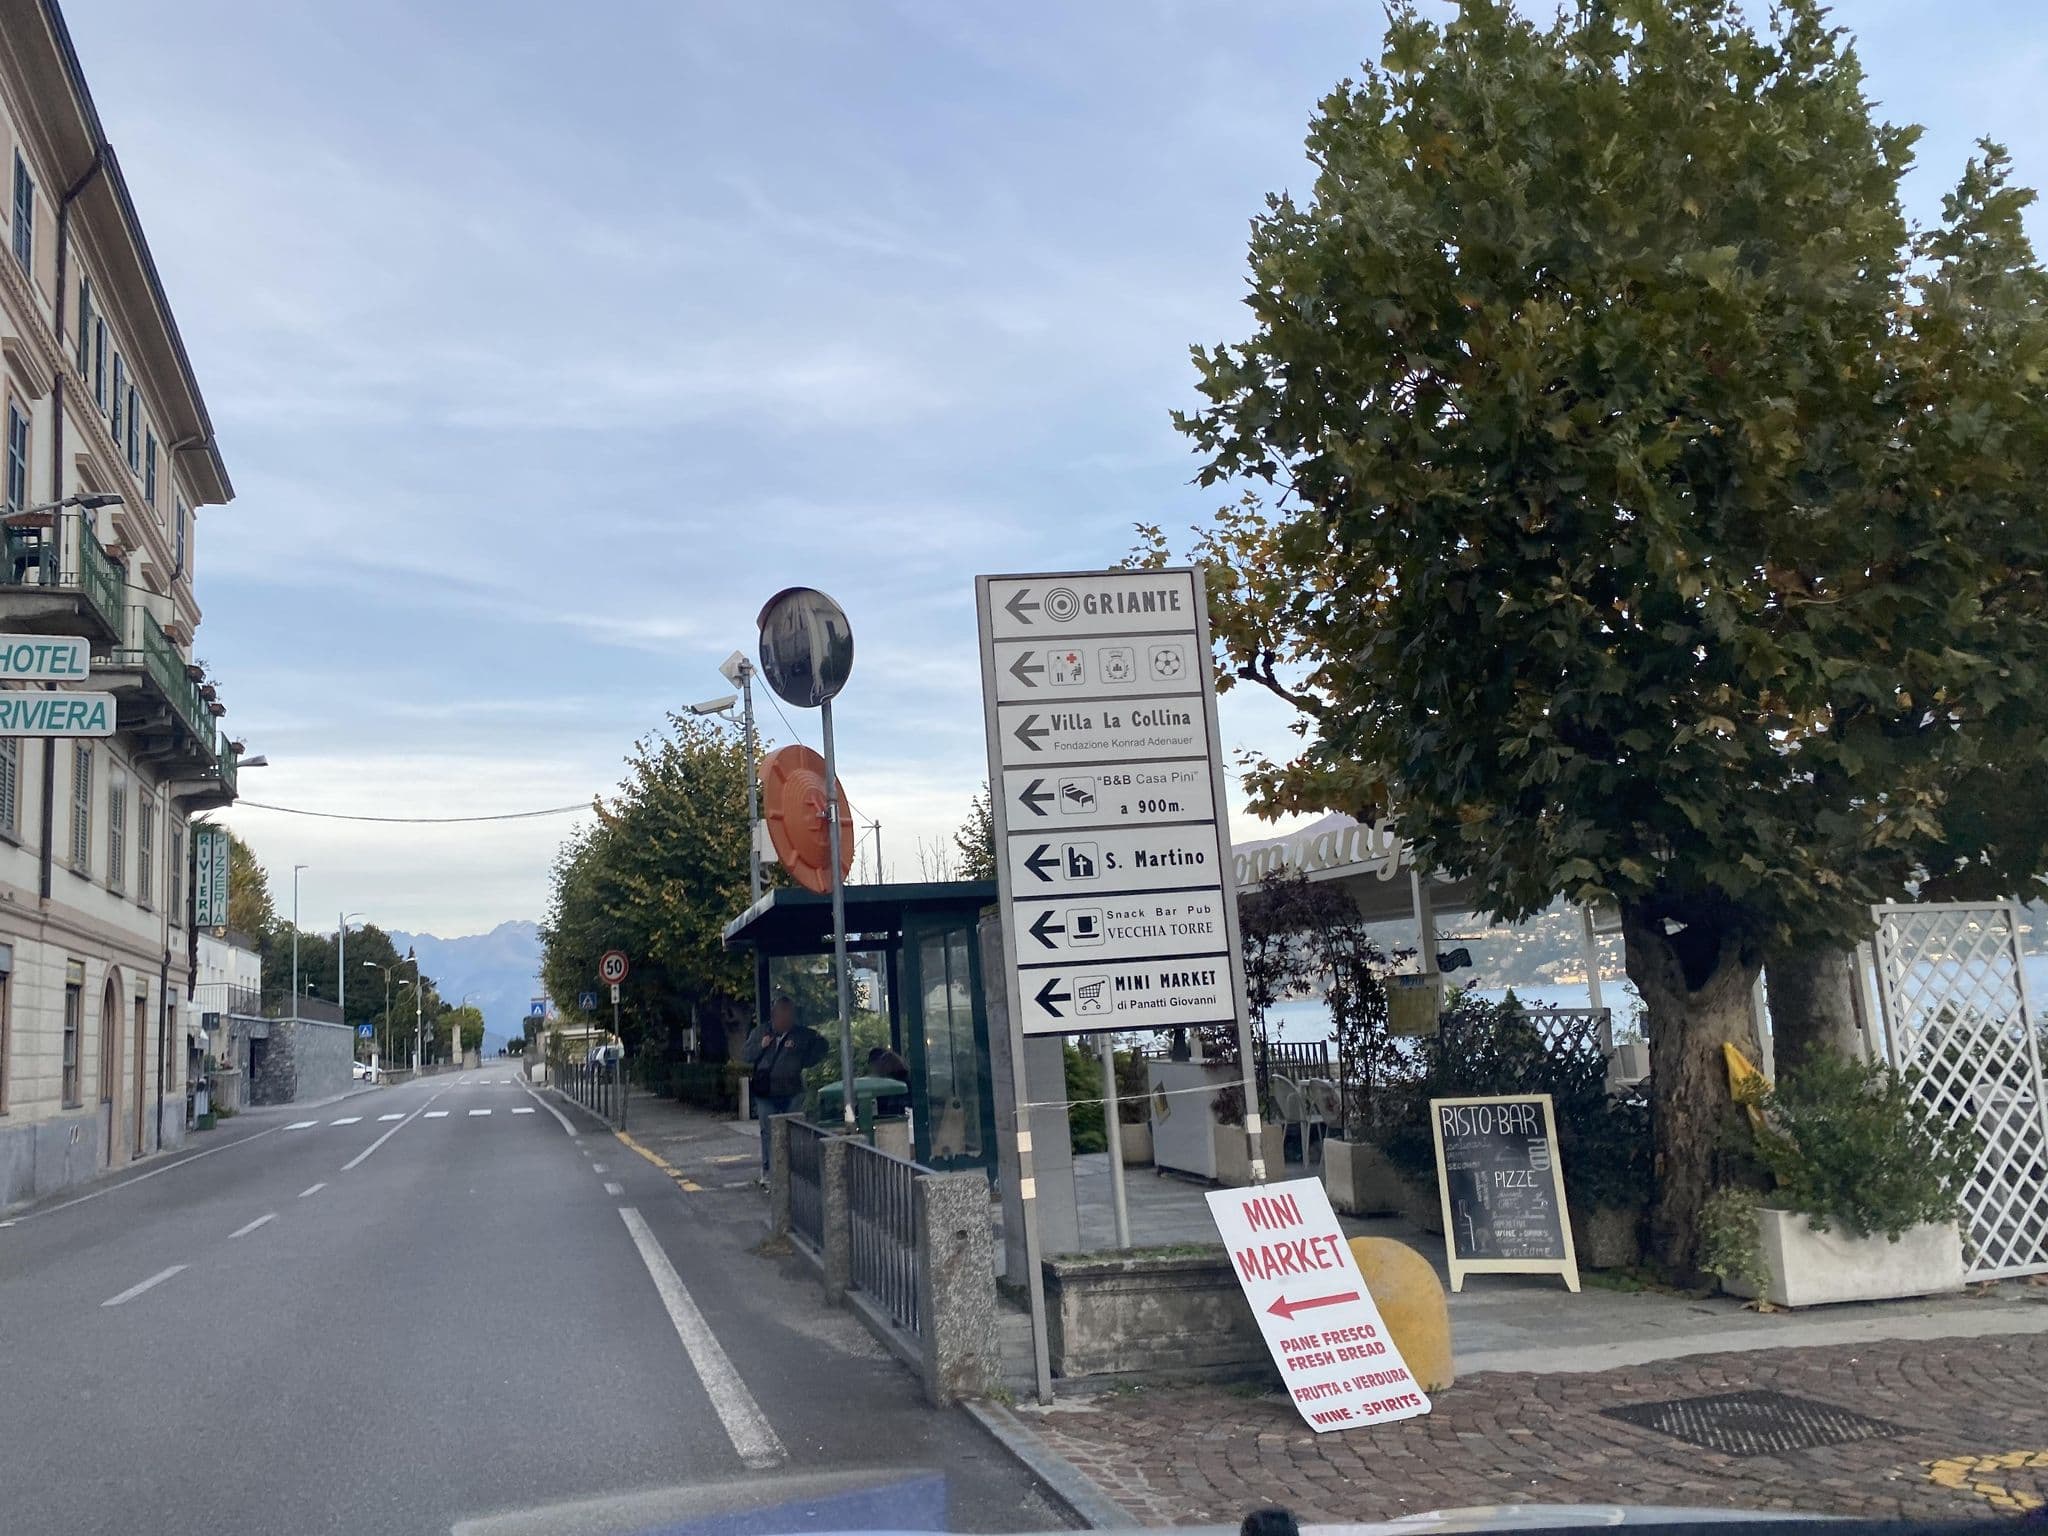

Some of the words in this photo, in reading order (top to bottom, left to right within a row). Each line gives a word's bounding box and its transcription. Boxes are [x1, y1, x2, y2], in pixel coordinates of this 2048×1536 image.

[1083, 590, 1181, 615] GRIANTE
[0, 644, 83, 674] HOTEL
[0, 700, 106, 730] RIVIERA
[1051, 713, 1092, 731] Villa
[1104, 712, 1121, 729] La
[1132, 709, 1191, 727] Collina
[1054, 740, 1109, 750] Fondazione
[1111, 738, 1145, 748] Konrad
[1147, 736, 1193, 746] Adenauer
[1136, 774, 1167, 784] Casa
[1120, 804, 1128, 814] a
[1138, 799, 1184, 813] 900m.
[1106, 852, 1122, 869] S.
[1135, 848, 1205, 868] Martino
[198, 835, 210, 924] RIVIERA
[213, 834, 225, 924] PIZZERIA
[1107, 908, 1145, 920] Snack
[1156, 907, 1177, 917] Bar
[1187, 905, 1211, 915] Pub
[1107, 925, 1166, 939] VECCHIA
[1169, 921, 1213, 935] TORRE
[607, 959, 622, 975] 50
[1115, 974, 1150, 992] MINI
[1160, 970, 1217, 989] MARKET
[1117, 1000, 1127, 1010] di
[1130, 997, 1167, 1010] Panatti
[1169, 995, 1217, 1006] Giovanni
[1441, 1104, 1538, 1137] RISTO-BAR
[1494, 1170, 1539, 1188] PIZZE
[1242, 1193, 1304, 1233] MINI
[1236, 1234, 1345, 1283] MARKET
[1280, 1334, 1321, 1354] PANE
[1322, 1324, 1377, 1346] FRESCO
[1286, 1350, 1336, 1372] FRESH
[1337, 1342, 1386, 1363] BREAD
[1293, 1382, 1342, 1403] FRUTTA
[1344, 1381, 1353, 1393] e
[1353, 1367, 1410, 1391] VERDURA
[1311, 1407, 1351, 1425] WINE
[1362, 1393, 1421, 1417] SPIRITS
